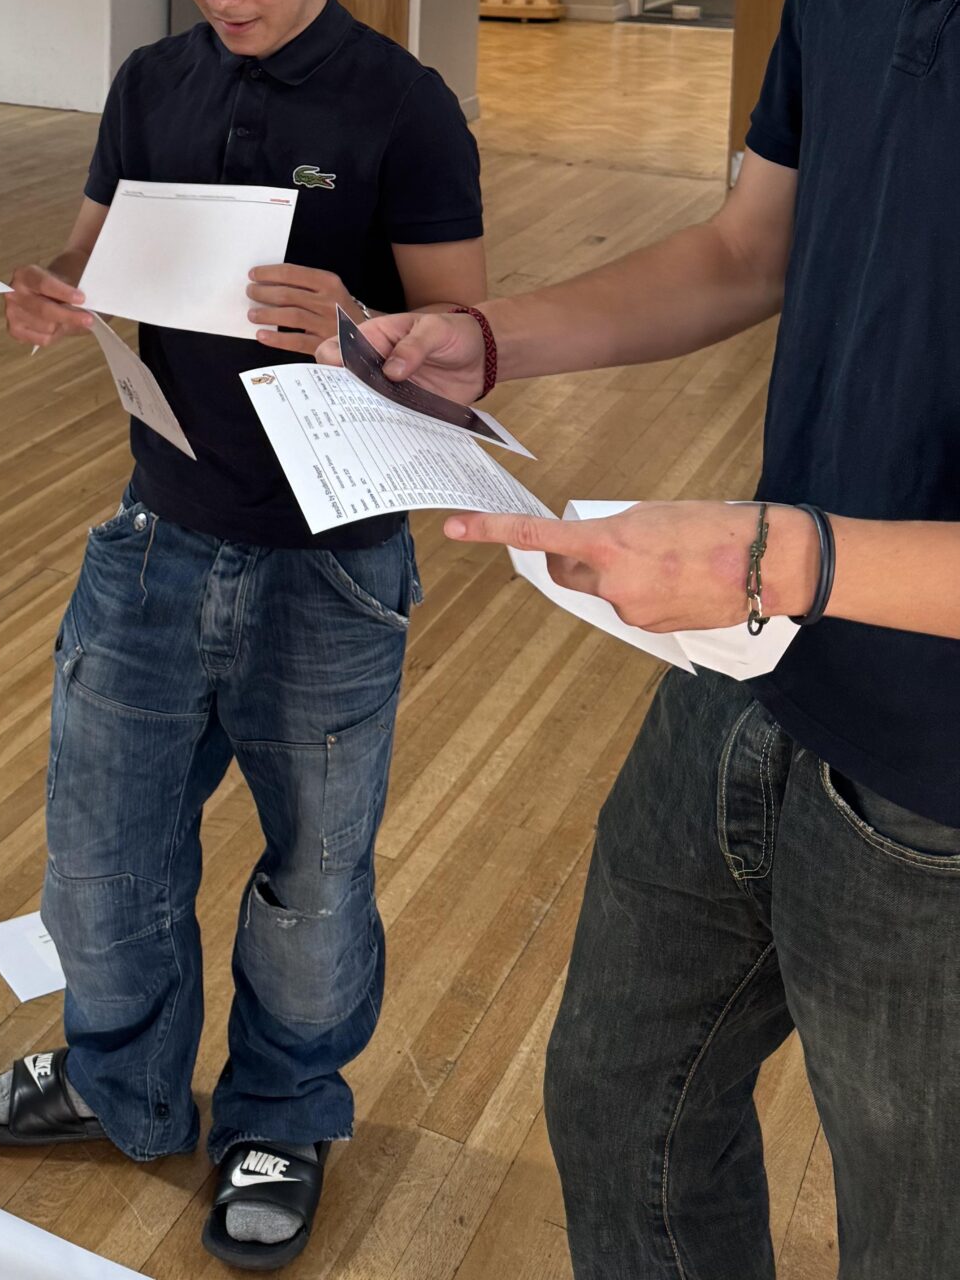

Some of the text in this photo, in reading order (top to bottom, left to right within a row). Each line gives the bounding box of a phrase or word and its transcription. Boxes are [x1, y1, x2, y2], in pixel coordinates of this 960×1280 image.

[311, 463, 324, 479] Report
[318, 477, 332, 496] Student
[327, 493, 336, 502] by
[329, 501, 343, 519] Results
[35, 1052, 54, 1076] NIKE
[241, 1150, 290, 1178] NIKE
